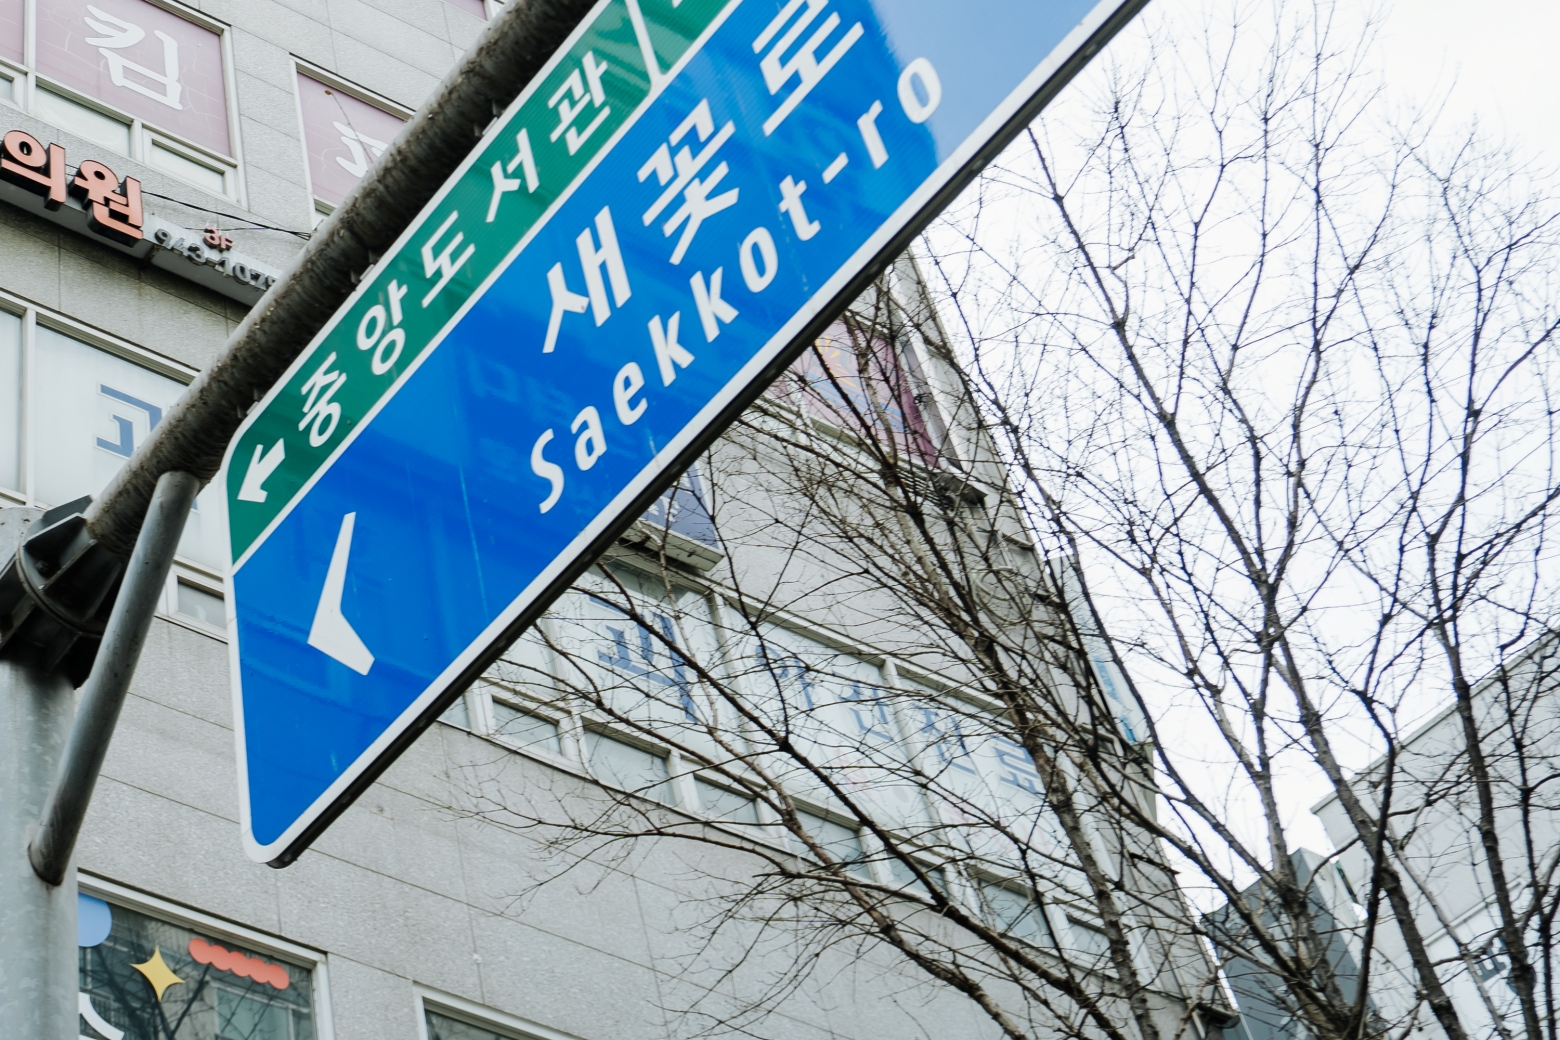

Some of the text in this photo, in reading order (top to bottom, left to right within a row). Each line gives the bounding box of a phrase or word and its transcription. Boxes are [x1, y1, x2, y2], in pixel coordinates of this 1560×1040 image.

[154, 228, 278, 292] 943-107
[297, 51, 610, 447] 중앙도서관
[529, 57, 941, 513] Saekkot-ro
